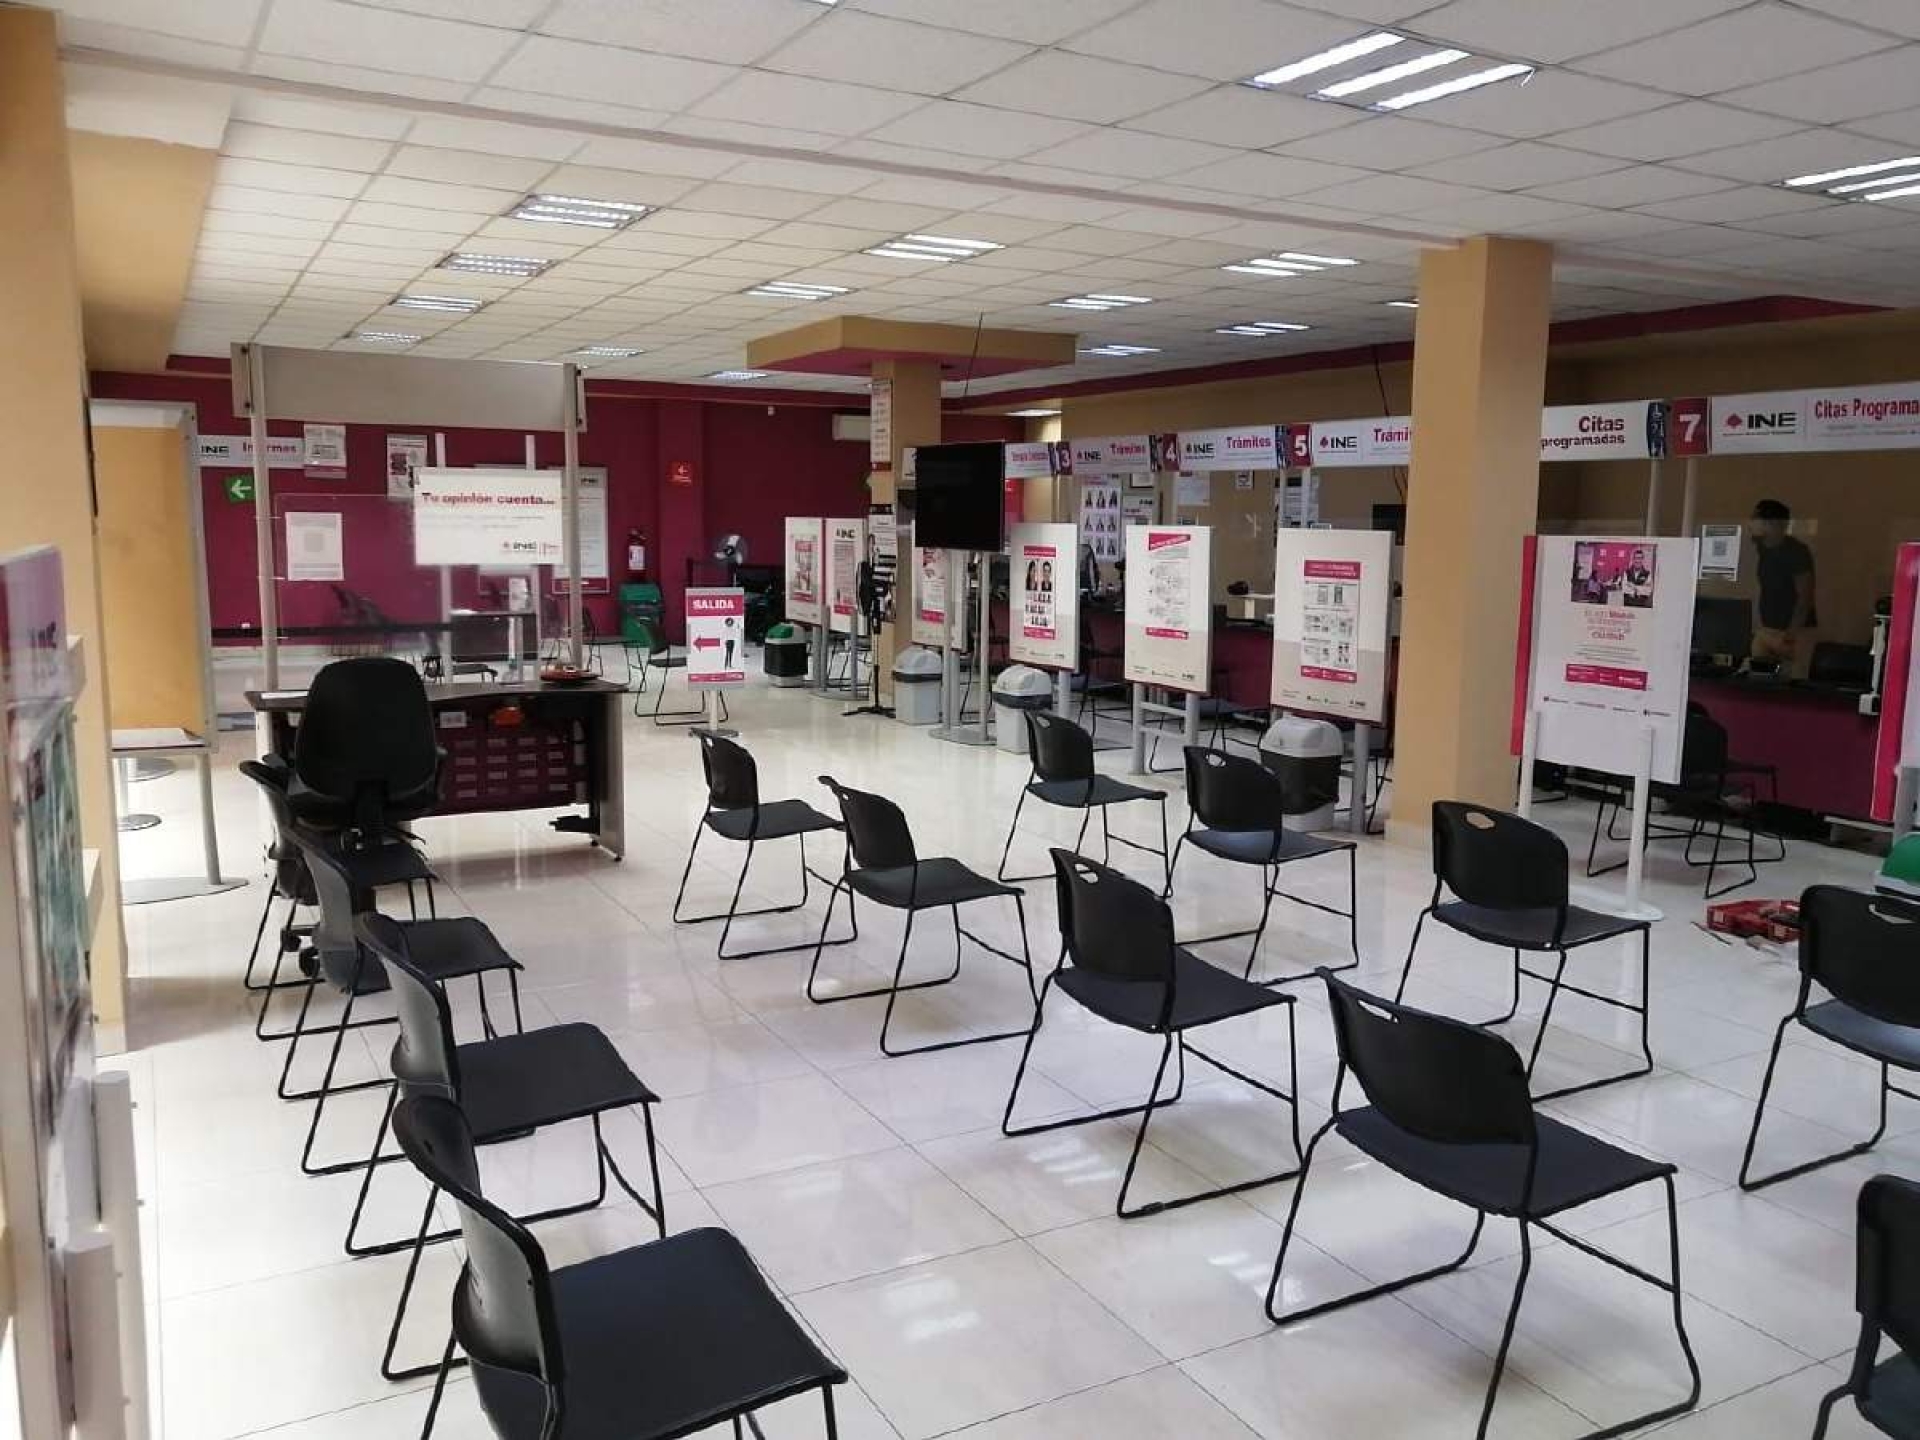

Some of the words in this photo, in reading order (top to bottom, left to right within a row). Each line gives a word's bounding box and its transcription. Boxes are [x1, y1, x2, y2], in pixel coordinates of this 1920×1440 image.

[1814, 400, 1848, 420] Citas
[1578, 416, 1625, 433] Citas
[1679, 414, 1702, 443] 7
[1747, 413, 1796, 430] INE
[1192, 443, 1214, 454] INE
[1294, 434, 1308, 457] 5
[1330, 436, 1358, 449] INE
[1541, 433, 1625, 449] programadas
[1060, 448, 1071, 468] 3
[1165, 443, 1178, 461] 4
[692, 599, 735, 610] SALIDA
